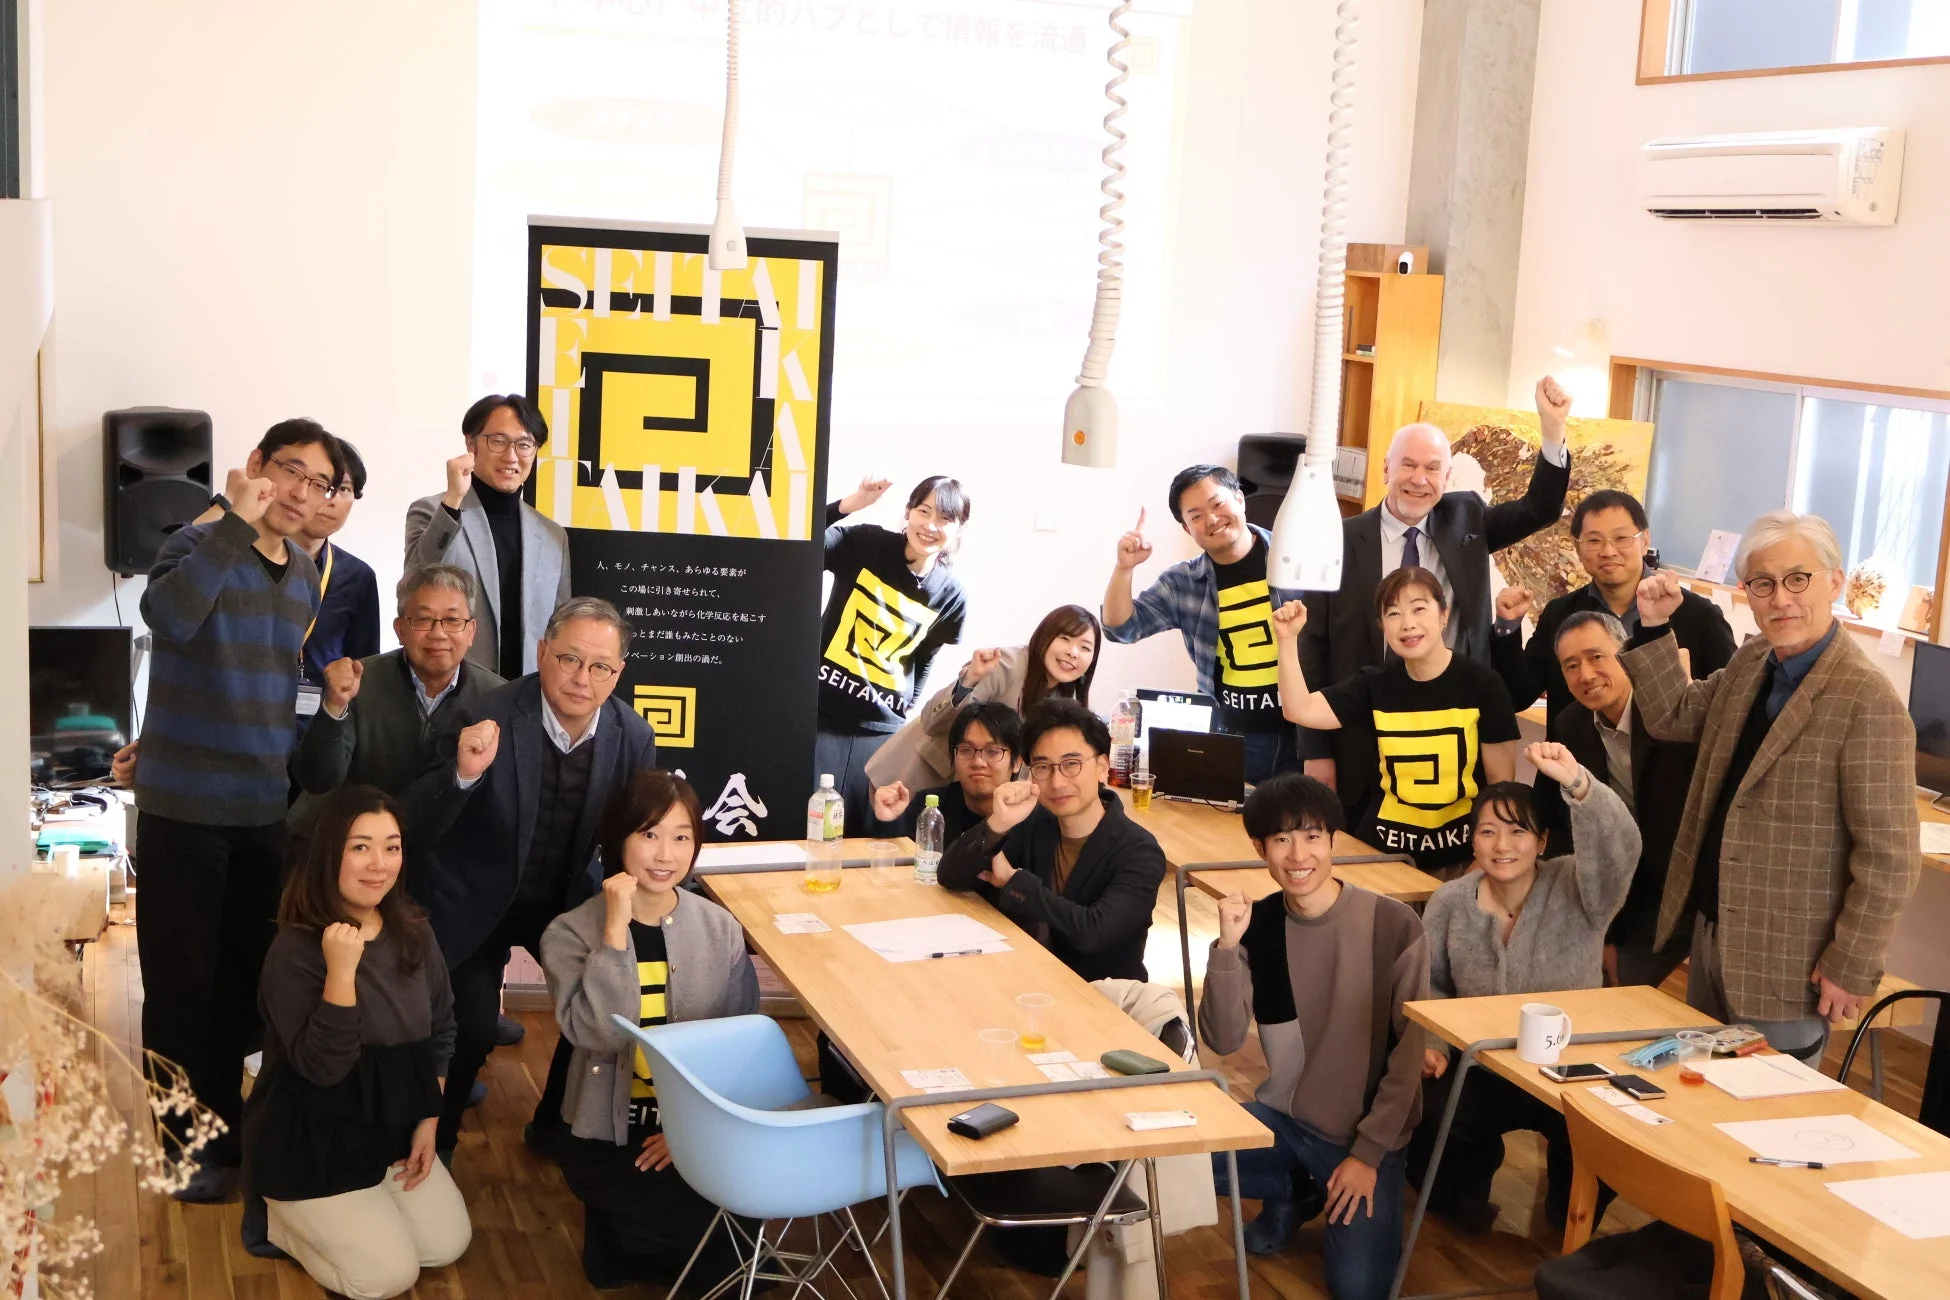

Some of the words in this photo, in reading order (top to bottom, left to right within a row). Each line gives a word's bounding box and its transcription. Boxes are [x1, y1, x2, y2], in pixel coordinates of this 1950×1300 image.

[620, 584, 720, 598] この場に引き寄せられて、
[626, 606, 767, 623] 刺激しあいながら化学反応を起こす
